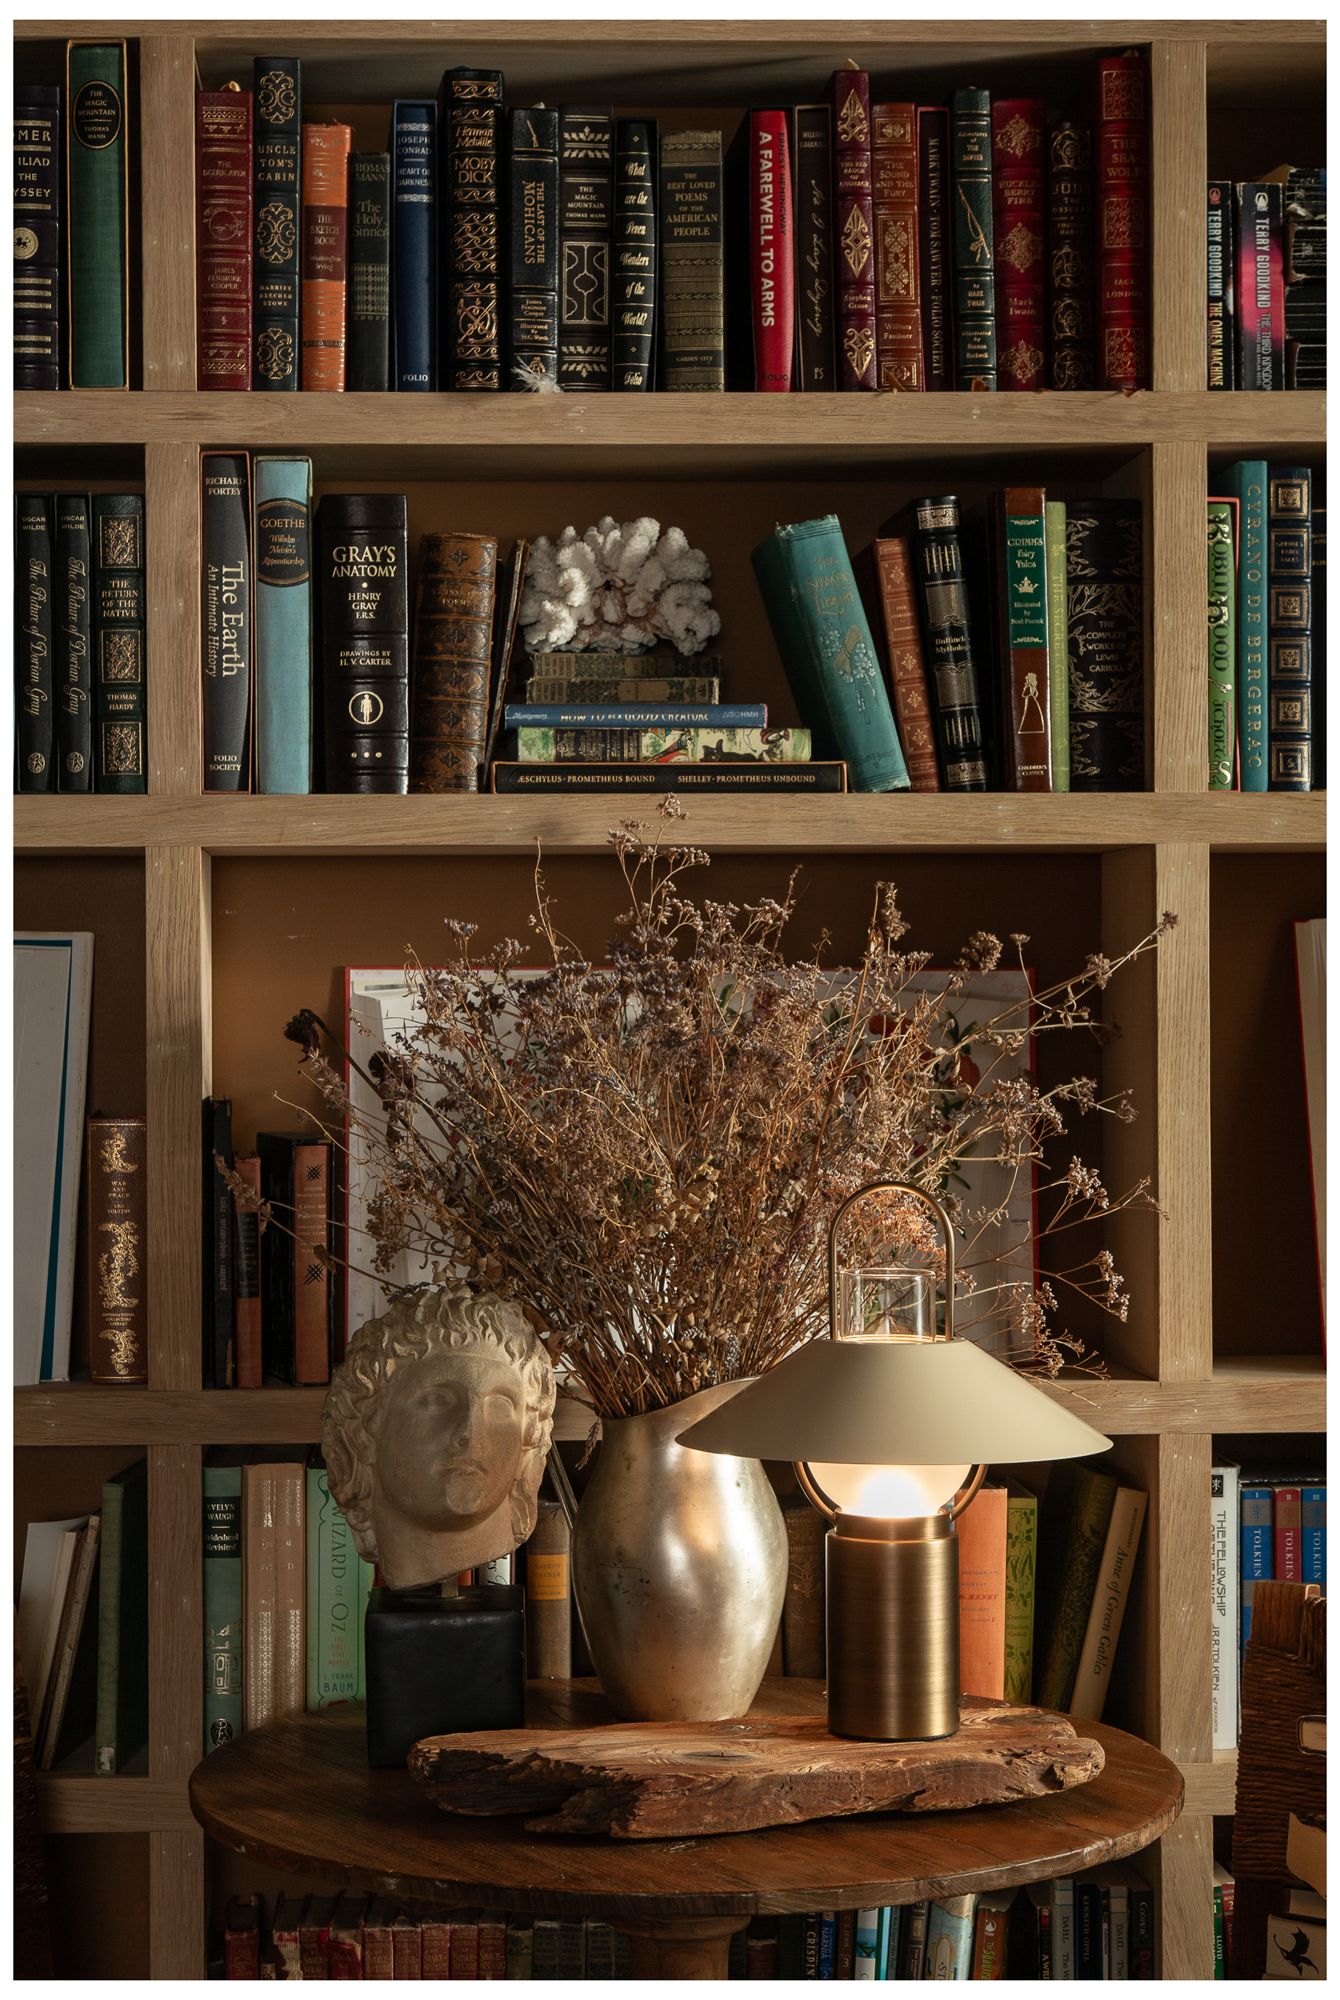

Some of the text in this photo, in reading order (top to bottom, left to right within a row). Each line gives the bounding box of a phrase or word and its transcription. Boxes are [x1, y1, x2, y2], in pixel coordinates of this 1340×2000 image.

[455, 126, 495, 137] Herman
[398, 135, 431, 145] JOSEPH
[1111, 138, 1138, 149] THE
[258, 145, 297, 155] UNCLE
[397, 147, 432, 155] CONRAD
[18, 157, 50, 167] ILIAD
[260, 159, 294, 168] TOM'S
[454, 157, 497, 170] MOBY
[1112, 153, 1137, 163] SEA
[217, 160, 232, 169] THE
[625, 161, 647, 177] What
[884, 161, 904, 169] THE
[17, 173, 38, 181] THE
[258, 172, 296, 182] CABIN
[398, 168, 421, 176] HEART
[458, 170, 495, 184] DICK
[879, 169, 909, 178] SOUND
[1106, 167, 1142, 177] WOLF
[355, 173, 386, 183] MANN
[397, 178, 433, 187] DARKNESS
[666, 180, 716, 190] BEST LOVED
[574, 193, 598, 201] MAGIC
[636, 191, 648, 205] the
[674, 192, 709, 202] POEMS
[884, 188, 906, 198] FURY
[357, 202, 382, 214] The
[567, 201, 605, 209] MOUNTAIN
[778, 171, 787, 235] HEMINGWAY
[316, 214, 333, 224] THE
[357, 213, 384, 228] Holy
[522, 179, 536, 265] MOHICANS
[536, 181, 546, 264] THE LAST OF THE
[666, 213, 718, 224] AMERICAN
[310, 226, 340, 235] SKETCH
[673, 226, 711, 237] PEOPLE
[759, 131, 775, 327] A FAREWELL TO ARMS
[1255, 218, 1270, 251] TERRY
[314, 237, 336, 246] BOOK
[620, 252, 650, 267] Wonders
[928, 137, 945, 376] MARK TWAIN TOM SAWYER FOLIO SOCIETY
[210, 282, 239, 290] COOPER
[1256, 254, 1271, 308] GOODKIND
[625, 281, 646, 299] of the
[1208, 210, 1225, 387] TERRY GOODKIND THE OMEN MACHINE
[621, 312, 648, 326] World?
[1262, 313, 1272, 329] THE
[1264, 331, 1273, 354] THIRD
[700, 354, 713, 362] CITY
[402, 373, 429, 382] FOLIO
[624, 372, 643, 386] Folio
[208, 487, 242, 496] FORTEY
[260, 518, 305, 528] GOETHE
[332, 546, 396, 563] GRAY'S
[1017, 549, 1035, 560] Fairy
[1015, 560, 1037, 569] Tales
[331, 565, 397, 579] ANATOMY
[109, 580, 131, 588] THE
[1053, 573, 1063, 601] THE
[101, 589, 138, 598] RETURN
[348, 592, 382, 601] HENRY
[102, 599, 137, 608] OF THE
[351, 602, 378, 610] GRAY
[103, 609, 137, 618] NATIVE
[222, 560, 246, 677] The Earth
[22, 557, 49, 683] The of Dorian
[61, 556, 87, 683] The of Dorian
[205, 564, 220, 678] An Intimate History
[1247, 484, 1263, 769] CYRANO DE BERGERAC
[340, 650, 391, 658] DRAWINGS BY
[340, 657, 392, 667] H. CARTER
[107, 693, 137, 701] THOMAS
[740, 710, 759, 718] HMH
[213, 754, 238, 762] FOLIO
[209, 763, 242, 771] SOCIETY
[517, 774, 656, 784] ÆSCHYLUS PROMETHEUS BOUND
[678, 774, 816, 784] SHELLEY PROMETHEUS UNBOUND
[207, 1503, 237, 1511] EVELYN
[207, 1513, 236, 1521] WAUGH
[331, 1503, 348, 1580] WIZARD
[1252, 1528, 1262, 1577] TOLKIEN
[1285, 1530, 1294, 1579] TOLKIEN
[1312, 1530, 1321, 1579] TOLKIEN
[1216, 1510, 1227, 1617] THE FELLOWSHIP
[335, 1585, 343, 1596] OF
[968, 1593, 999, 1601] HENRY
[1093, 1546, 1129, 1676] Anne of Green Gables
[331, 1603, 349, 1632] OZ
[324, 1682, 354, 1693] BAUM
[1139, 1901, 1149, 1938] COOPER
[1062, 1915, 1070, 1968] DAHL The
[1116, 1923, 1124, 1952] DAHL
[820, 1927, 829, 1961] NARNIA
[1216, 1934, 1225, 1960] LLOYD
[806, 1931, 818, 1979] CRISPIN
